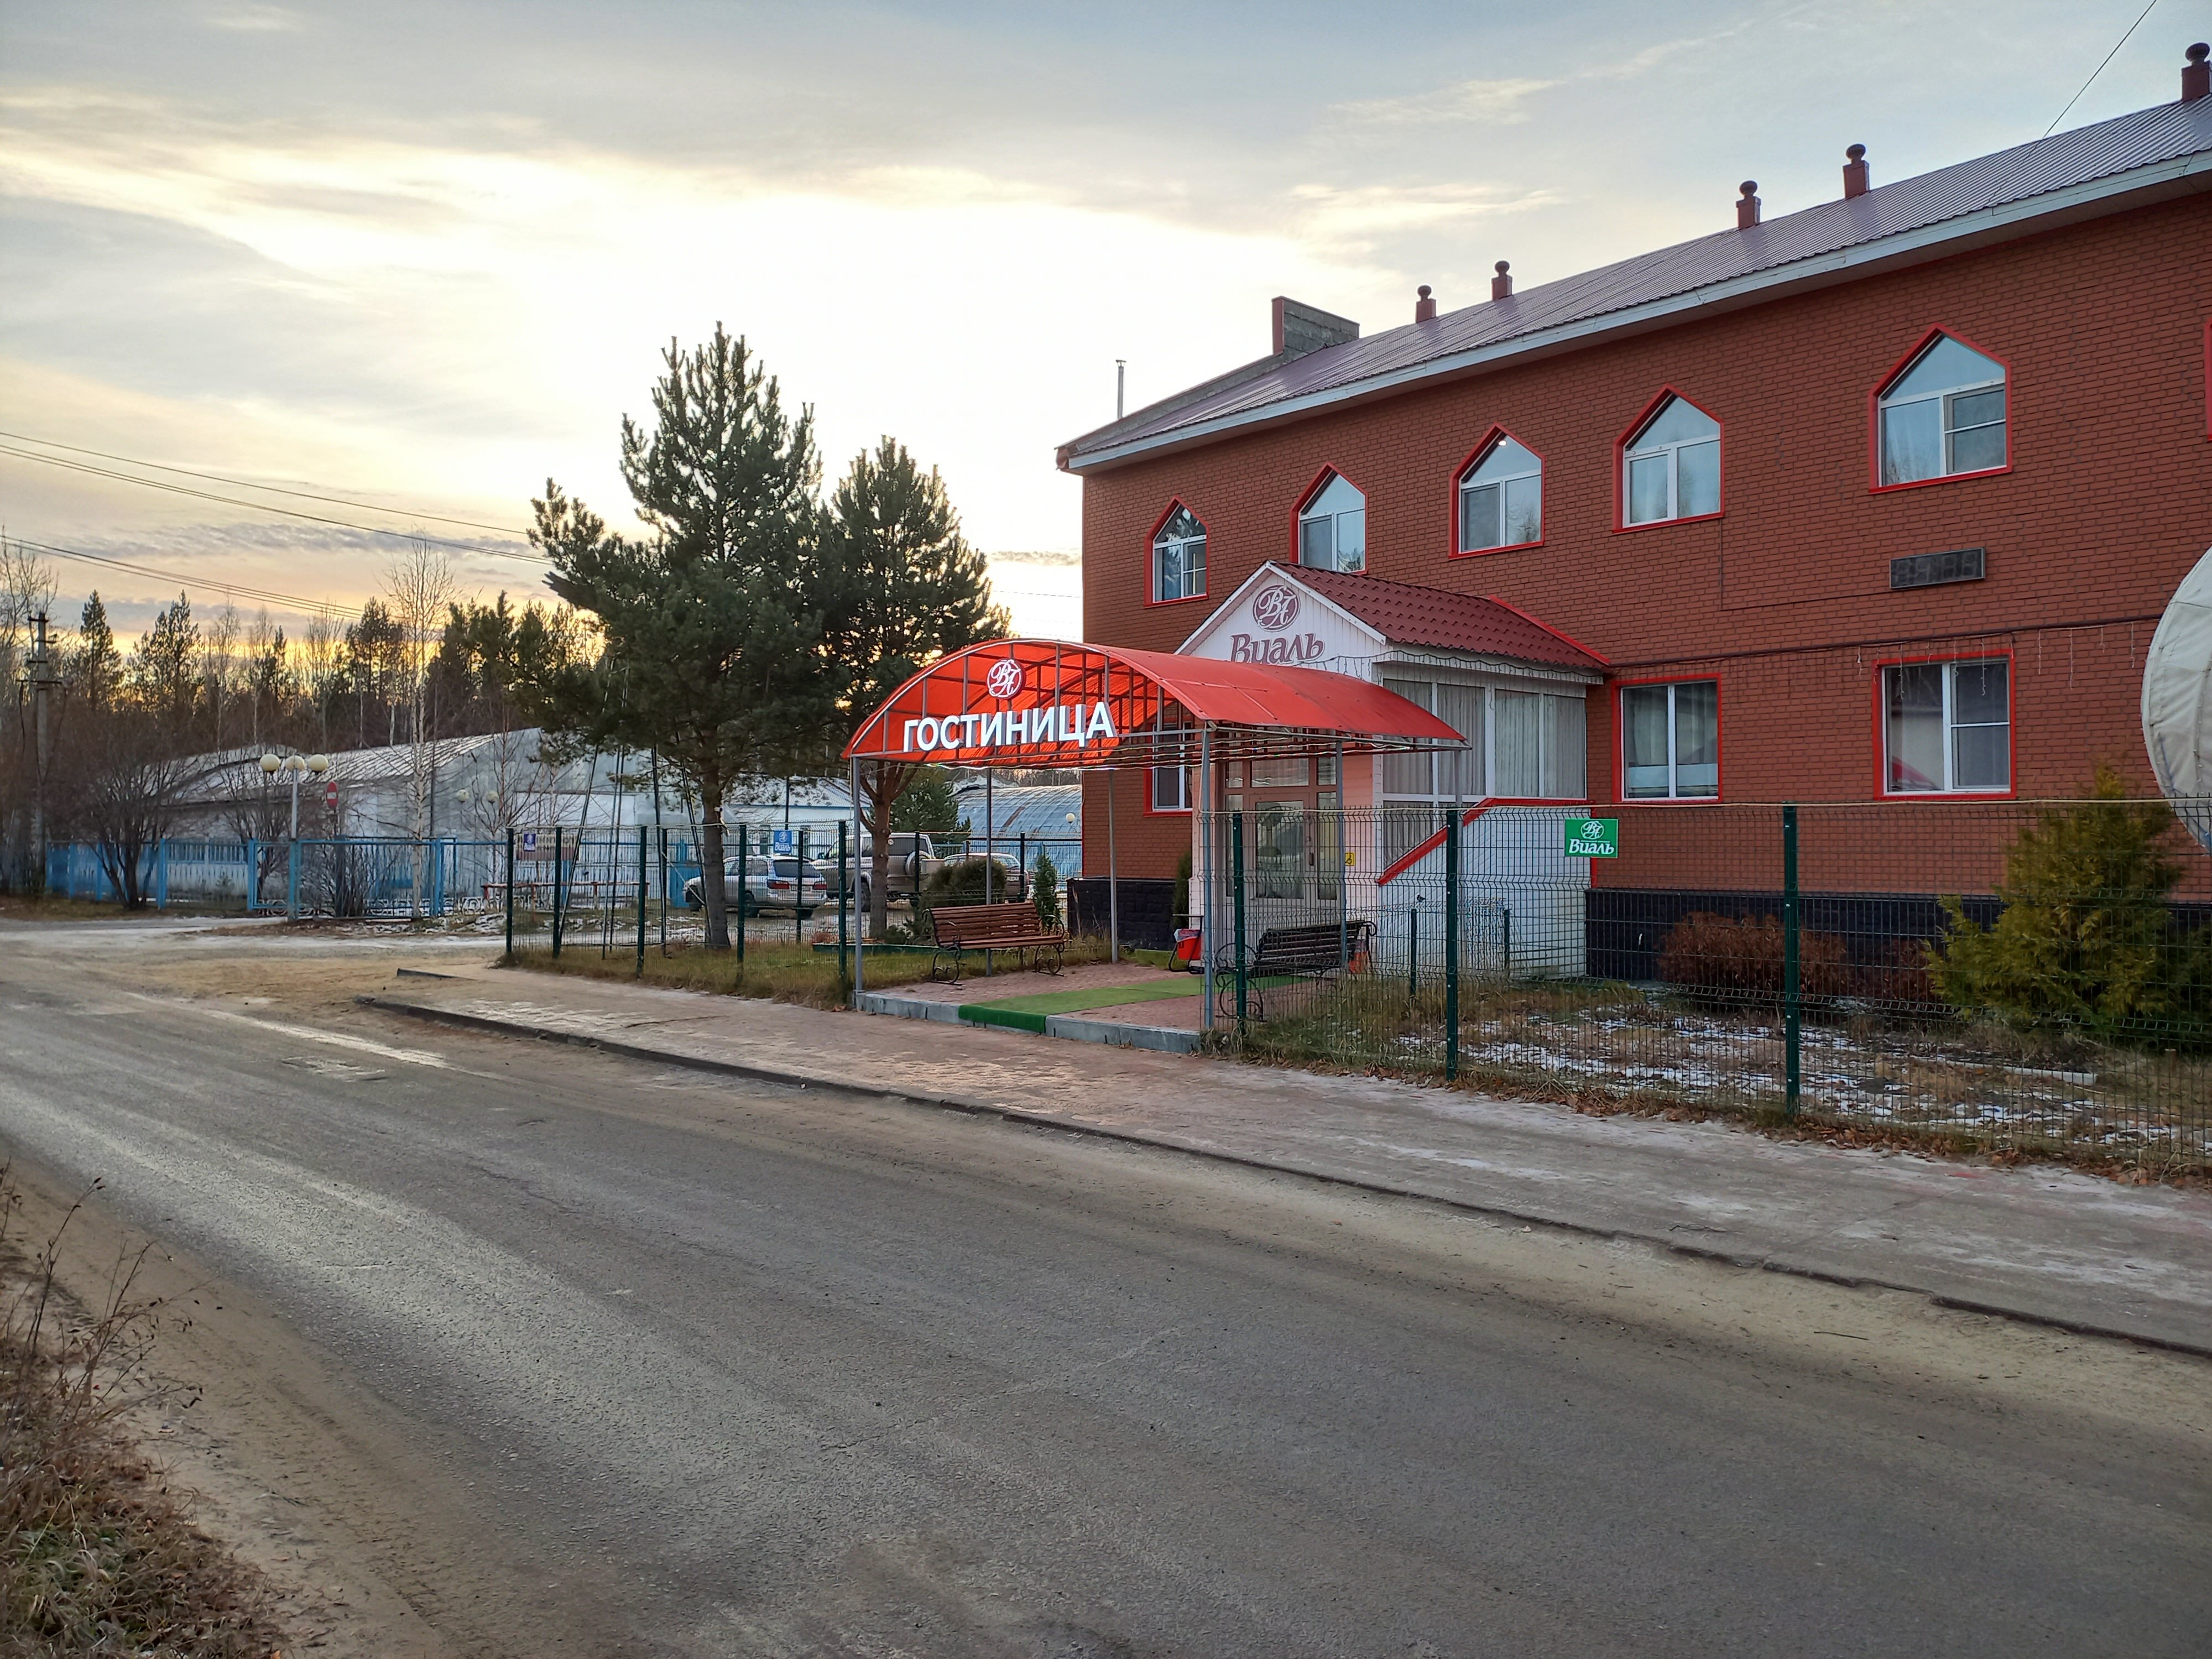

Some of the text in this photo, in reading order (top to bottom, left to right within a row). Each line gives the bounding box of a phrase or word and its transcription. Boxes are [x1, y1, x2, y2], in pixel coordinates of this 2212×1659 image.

[1231, 633, 1324, 664] Виаль
[903, 701, 1118, 753] ГОСТИНИЦА
[1569, 838, 1614, 854] Виаль
